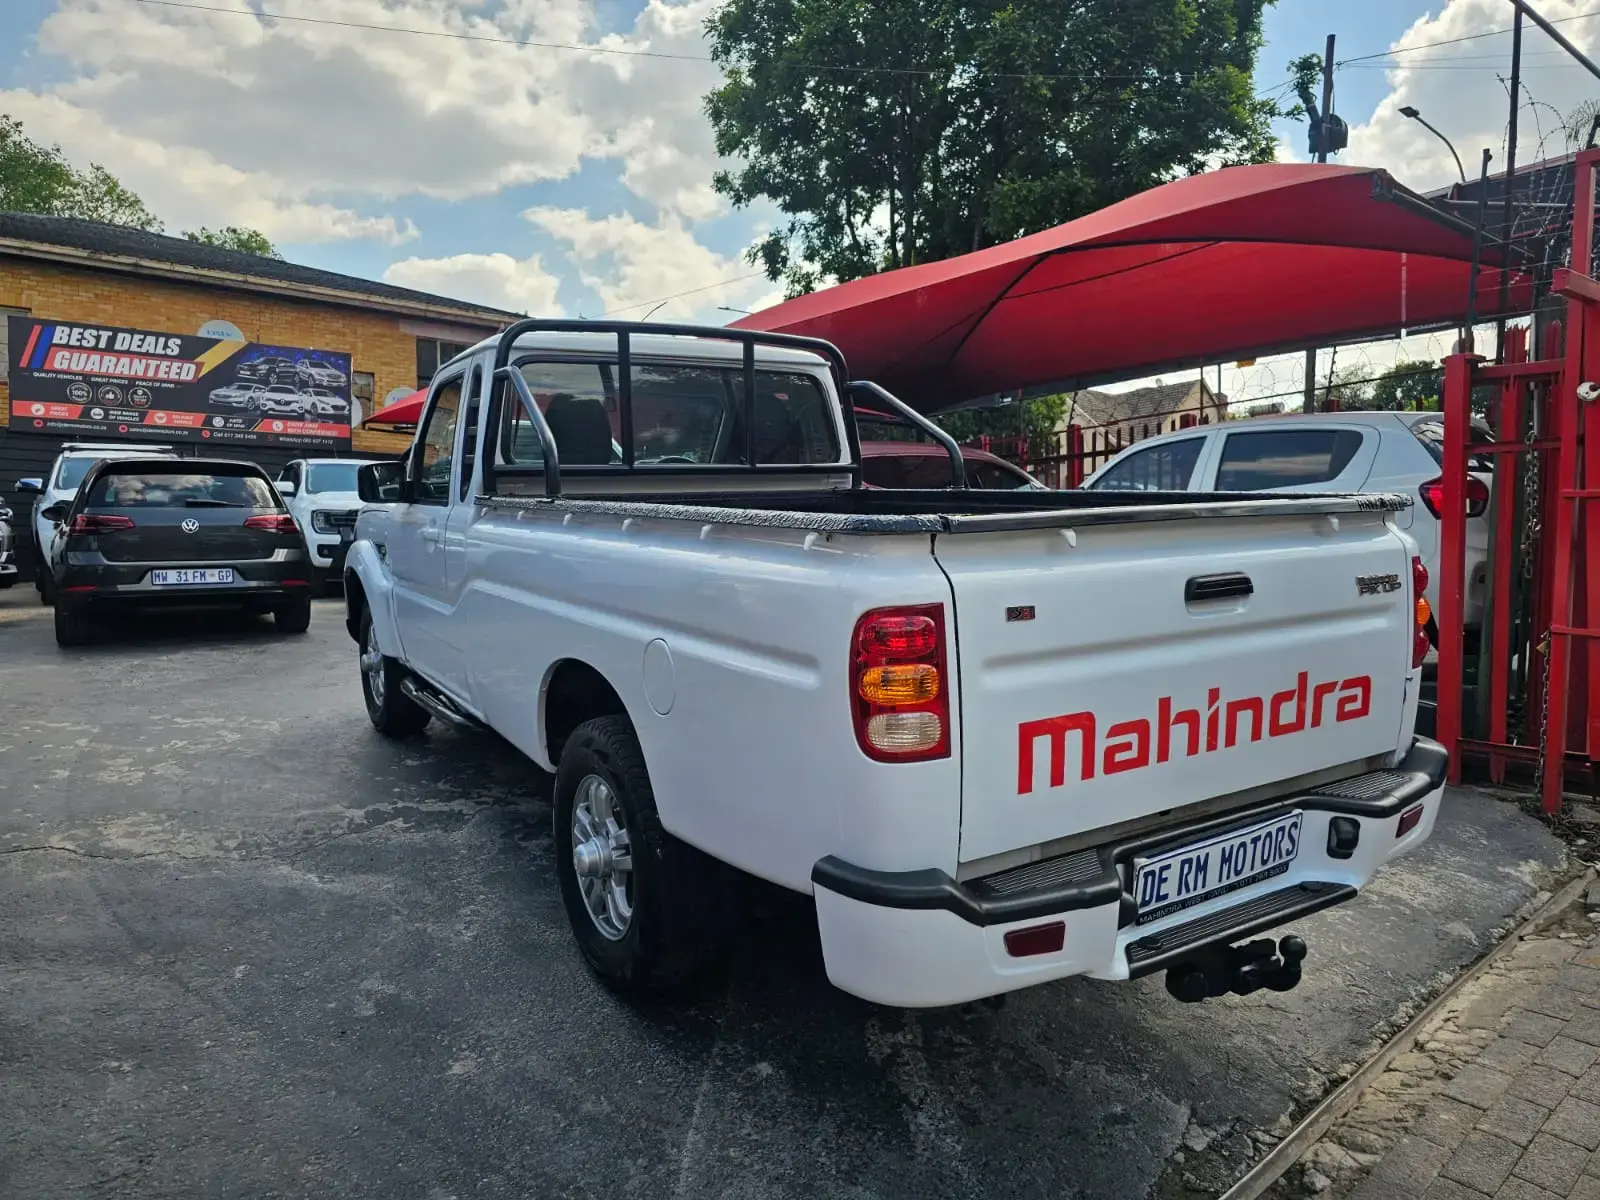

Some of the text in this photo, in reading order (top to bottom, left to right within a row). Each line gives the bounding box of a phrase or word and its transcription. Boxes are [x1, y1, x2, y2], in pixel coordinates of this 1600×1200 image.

[52, 325, 182, 356] BEST DEALS
[33, 371, 56, 379] QUALITY
[53, 351, 197, 380] GUARANTEED
[176, 570, 190, 583] 31
[192, 570, 207, 582] FM
[218, 569, 231, 581] GP
[1139, 820, 1299, 909] DE RM MOTORS
[1139, 902, 1183, 924] MAHINDRA
